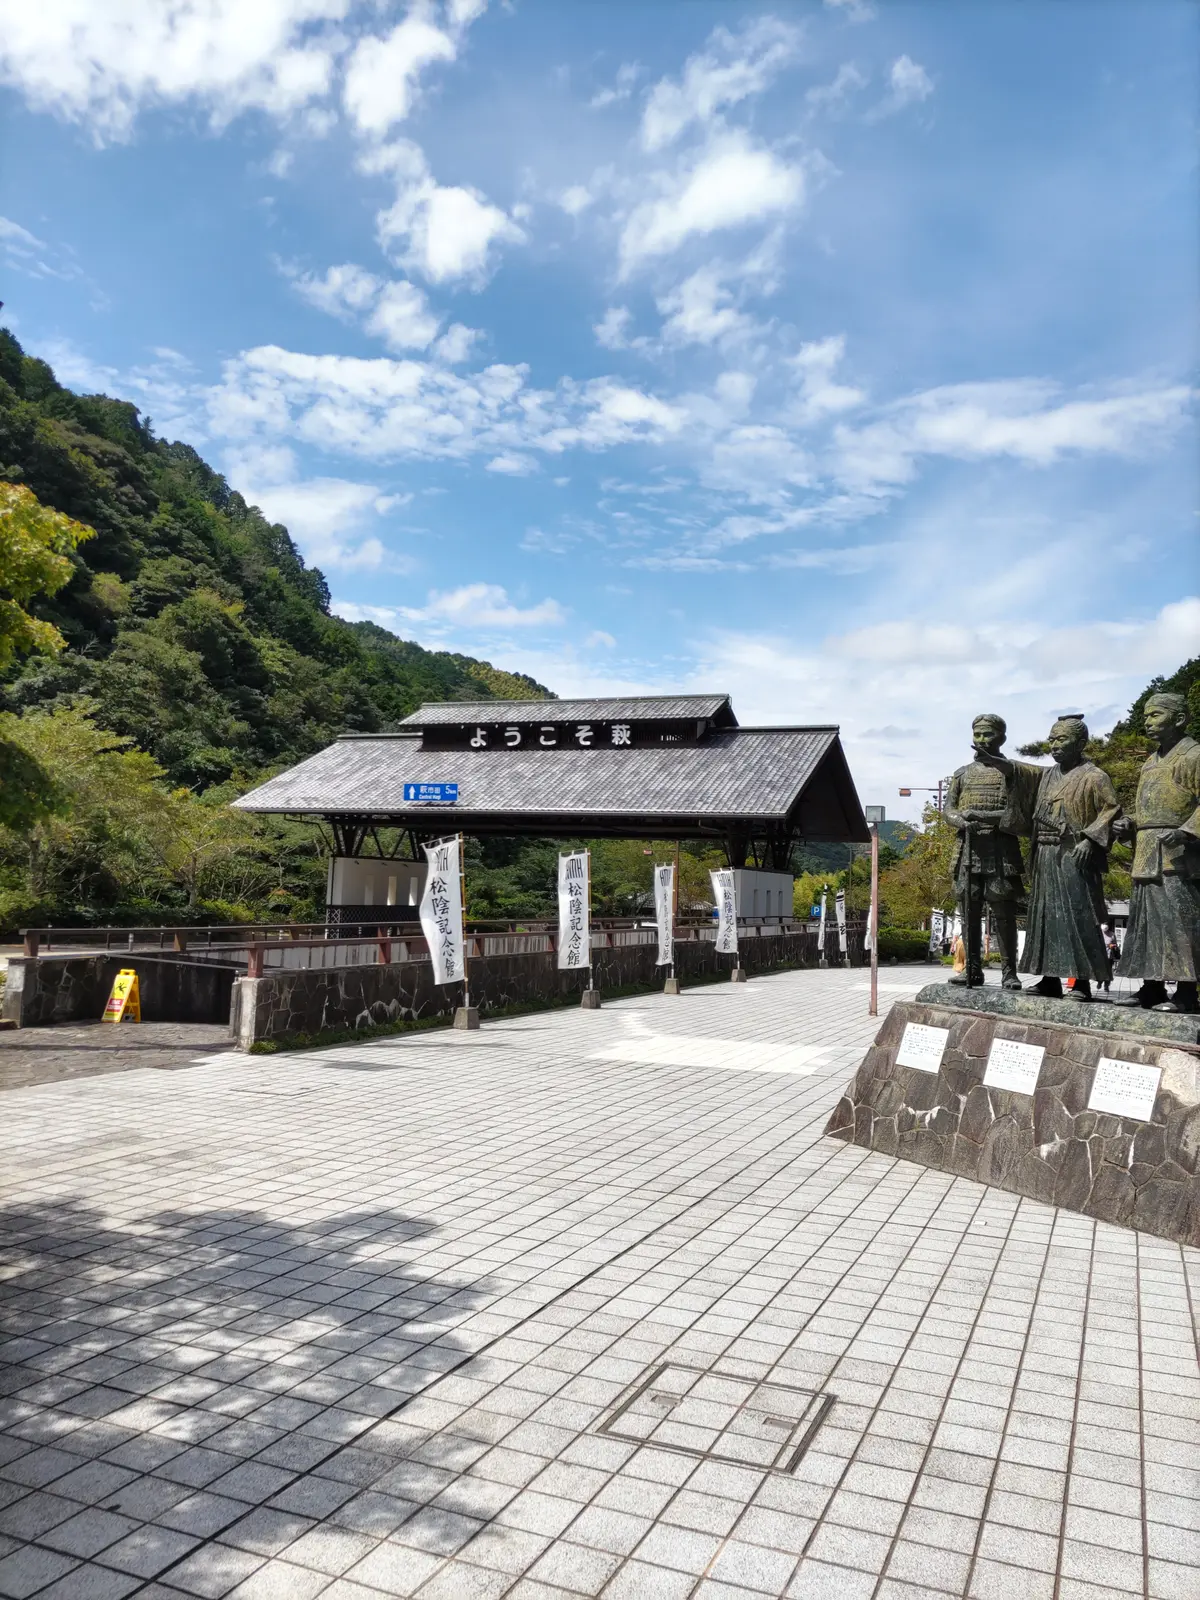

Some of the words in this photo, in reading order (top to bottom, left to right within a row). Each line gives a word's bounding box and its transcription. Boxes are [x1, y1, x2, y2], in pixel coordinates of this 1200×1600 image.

[470, 723, 632, 747] ようこそ萩
[429, 876, 456, 978] 松陰記念館
[565, 882, 583, 966] 松陰記念館
[722, 889, 735, 950] 松陰記念館
